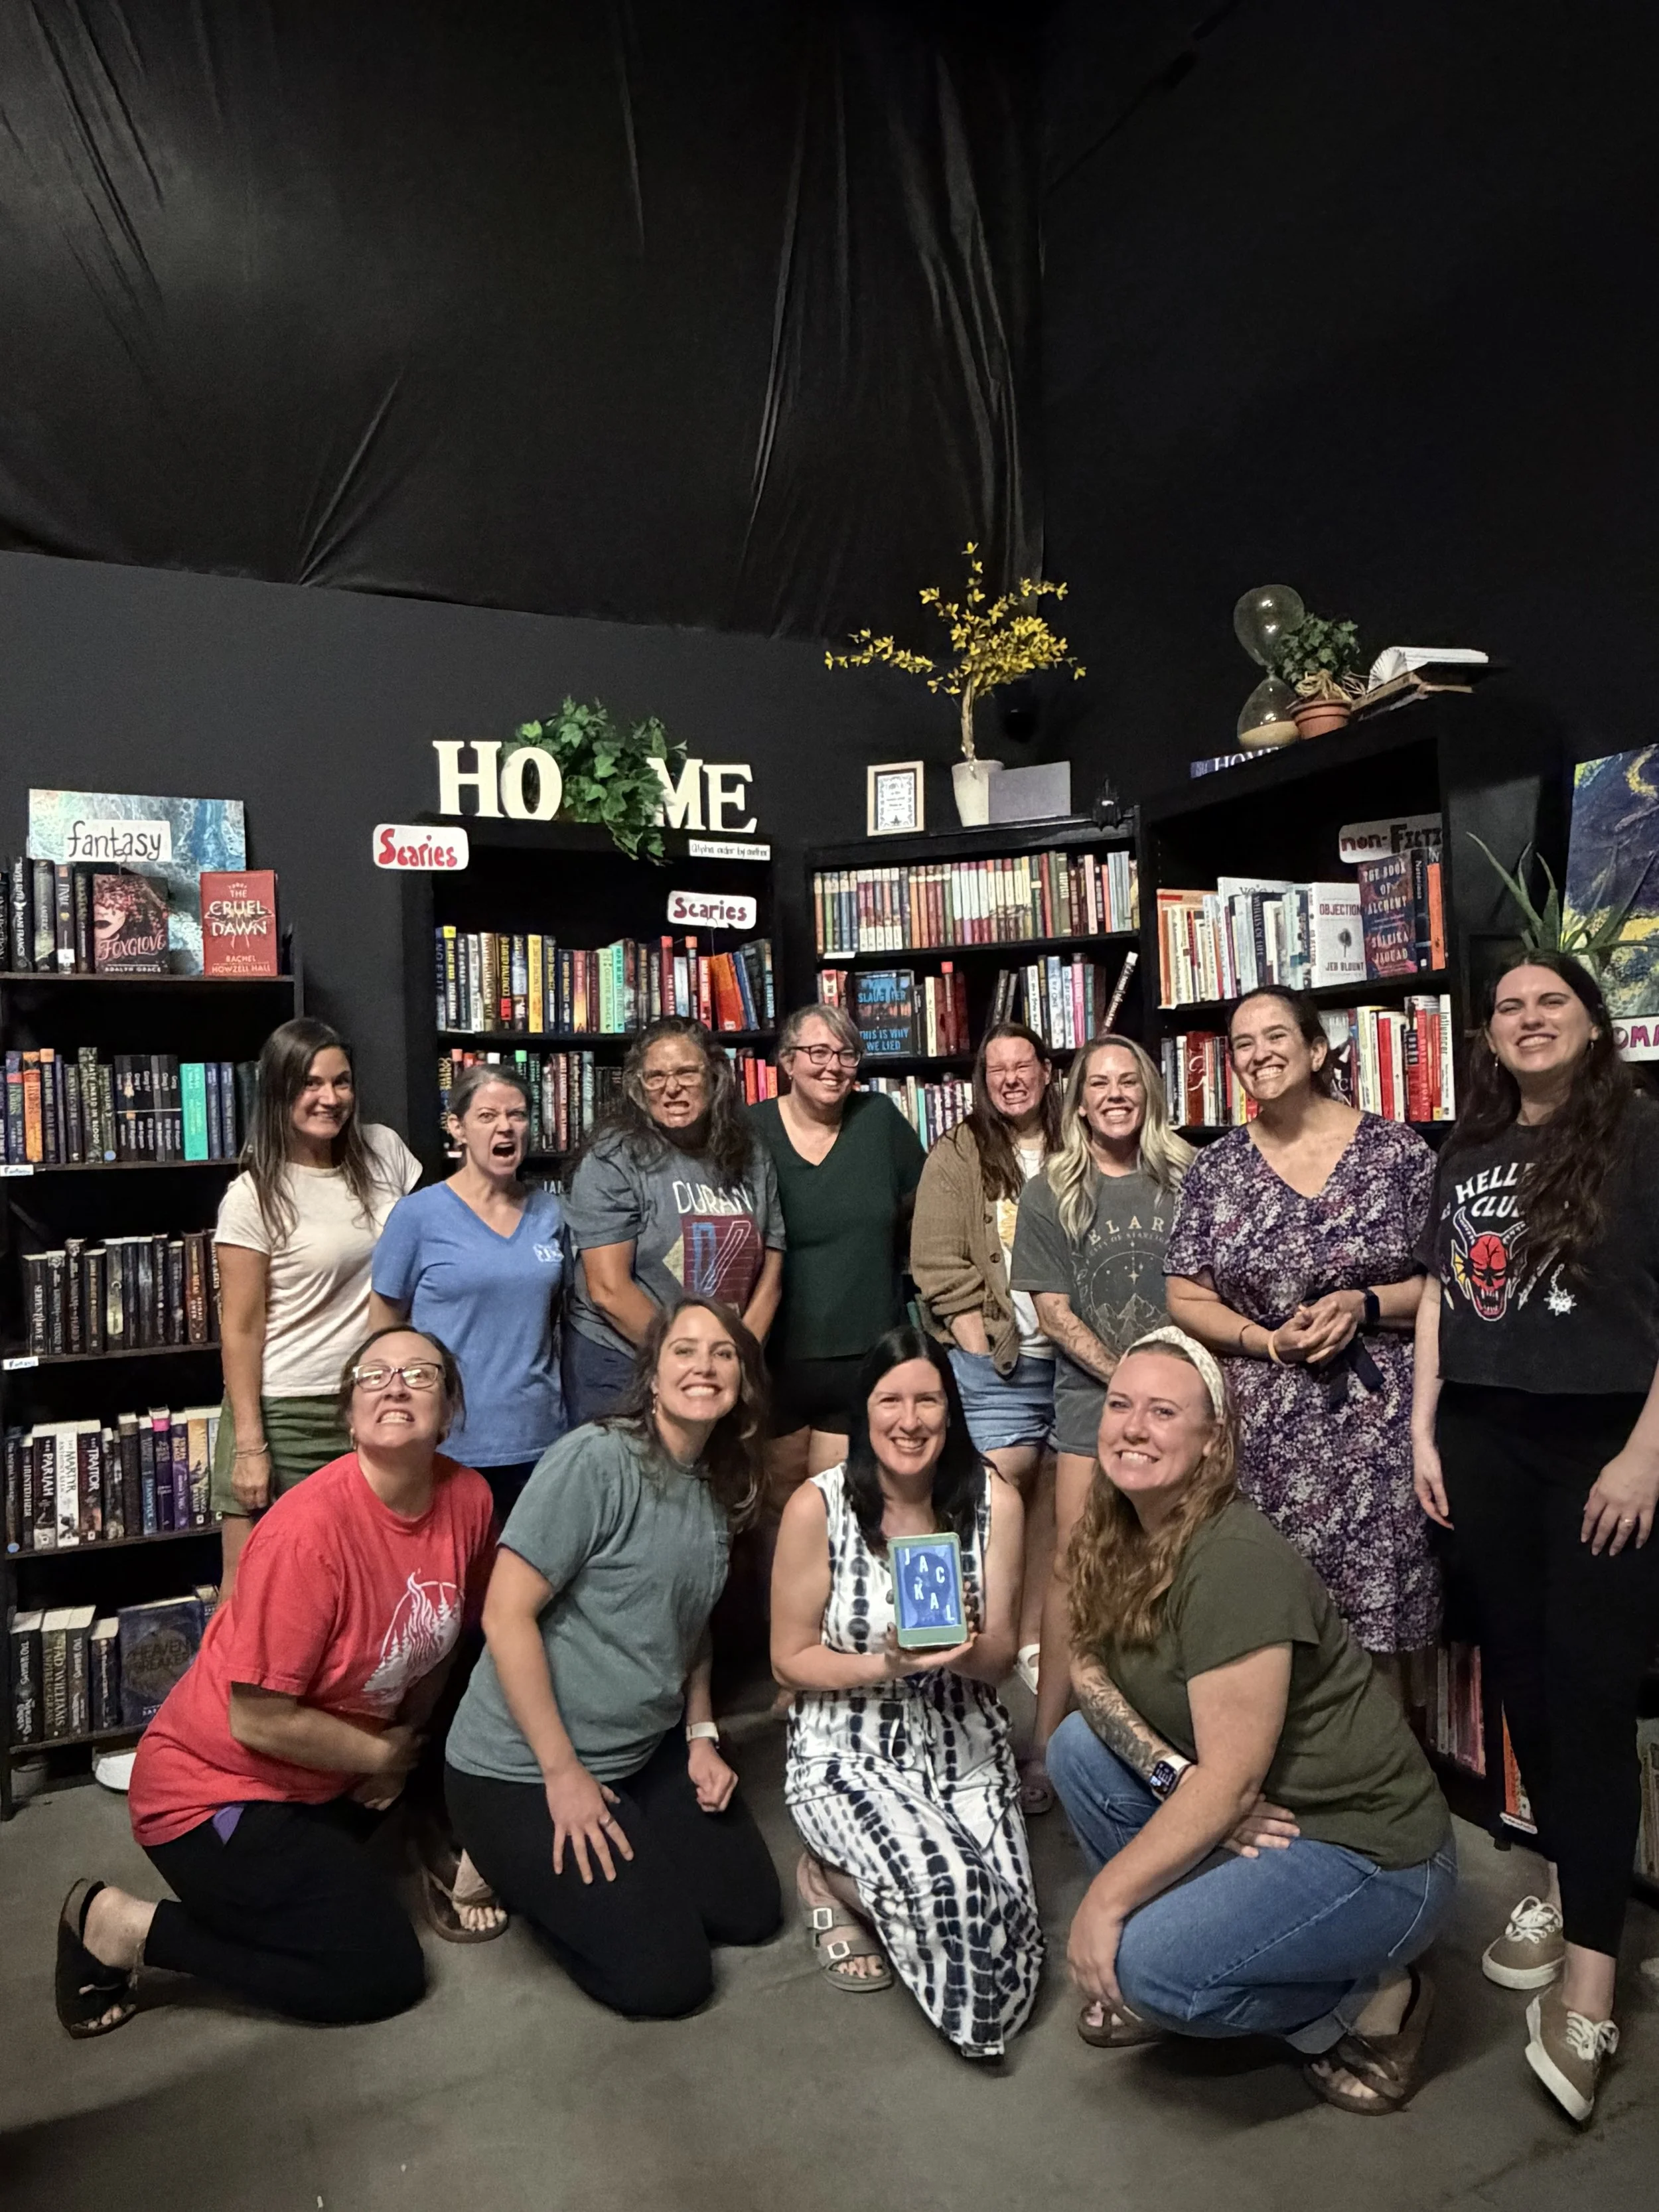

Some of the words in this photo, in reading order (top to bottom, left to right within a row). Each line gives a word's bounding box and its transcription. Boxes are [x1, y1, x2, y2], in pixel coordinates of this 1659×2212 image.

[67, 820, 161, 861] fantasy
[378, 828, 458, 867] Scaries
[737, 846, 745, 857] by
[1383, 859, 1406, 879] BOOK
[1380, 883, 1391, 895] OF
[210, 901, 265, 915] CRUEL
[673, 897, 747, 921] Scaries
[1368, 895, 1407, 915] ALCHEMY
[212, 921, 267, 936] DAWN
[99, 931, 166, 960] FOXGLOVE
[436, 944, 443, 960] NO
[1341, 962, 1364, 972] BLOUNT
[859, 1031, 877, 1039] THIS
[879, 1030, 888, 1039] IS
[890, 1029, 908, 1038] WHY
[866, 1042, 880, 1051] WE
[882, 1041, 901, 1050] LIED
[92, 1109, 98, 1118] IN
[672, 1180, 753, 1214] DURAN
[41, 1453, 54, 1496] PARIAH
[66, 1451, 76, 1493] MARTYR
[87, 1447, 100, 1492] TRAITOR
[54, 1645, 65, 1667] TAD
[54, 1670, 66, 1726] WILLIAMS
